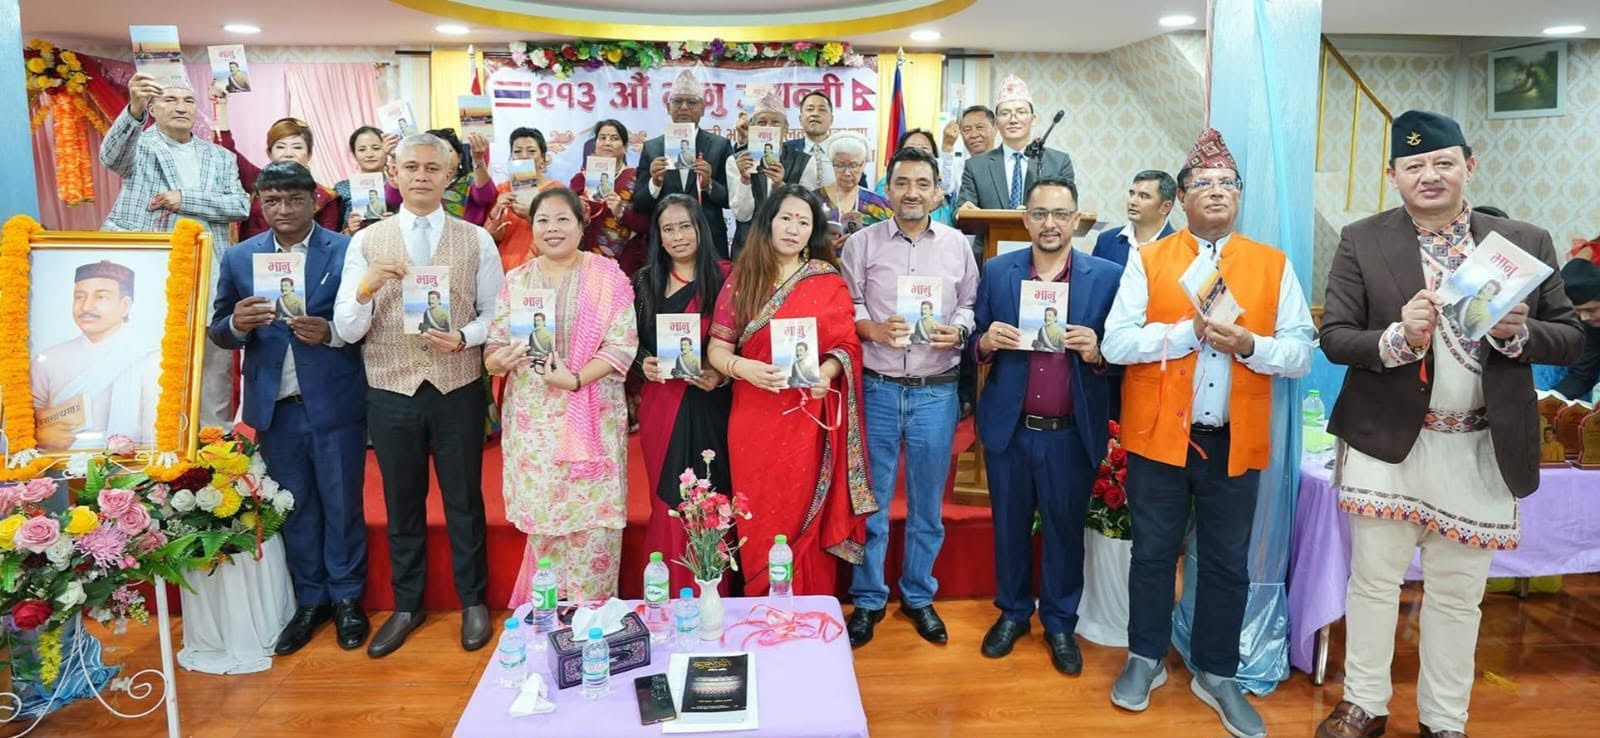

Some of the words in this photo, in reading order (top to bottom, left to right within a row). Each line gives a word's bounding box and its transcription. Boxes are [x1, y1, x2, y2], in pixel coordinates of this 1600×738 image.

[536, 81, 597, 113] २१३
[267, 261, 292, 273] भानु
[415, 274, 439, 287] भानु
[522, 296, 544, 309] भानु
[1033, 289, 1057, 304] भानु
[670, 321, 691, 334] भानु
